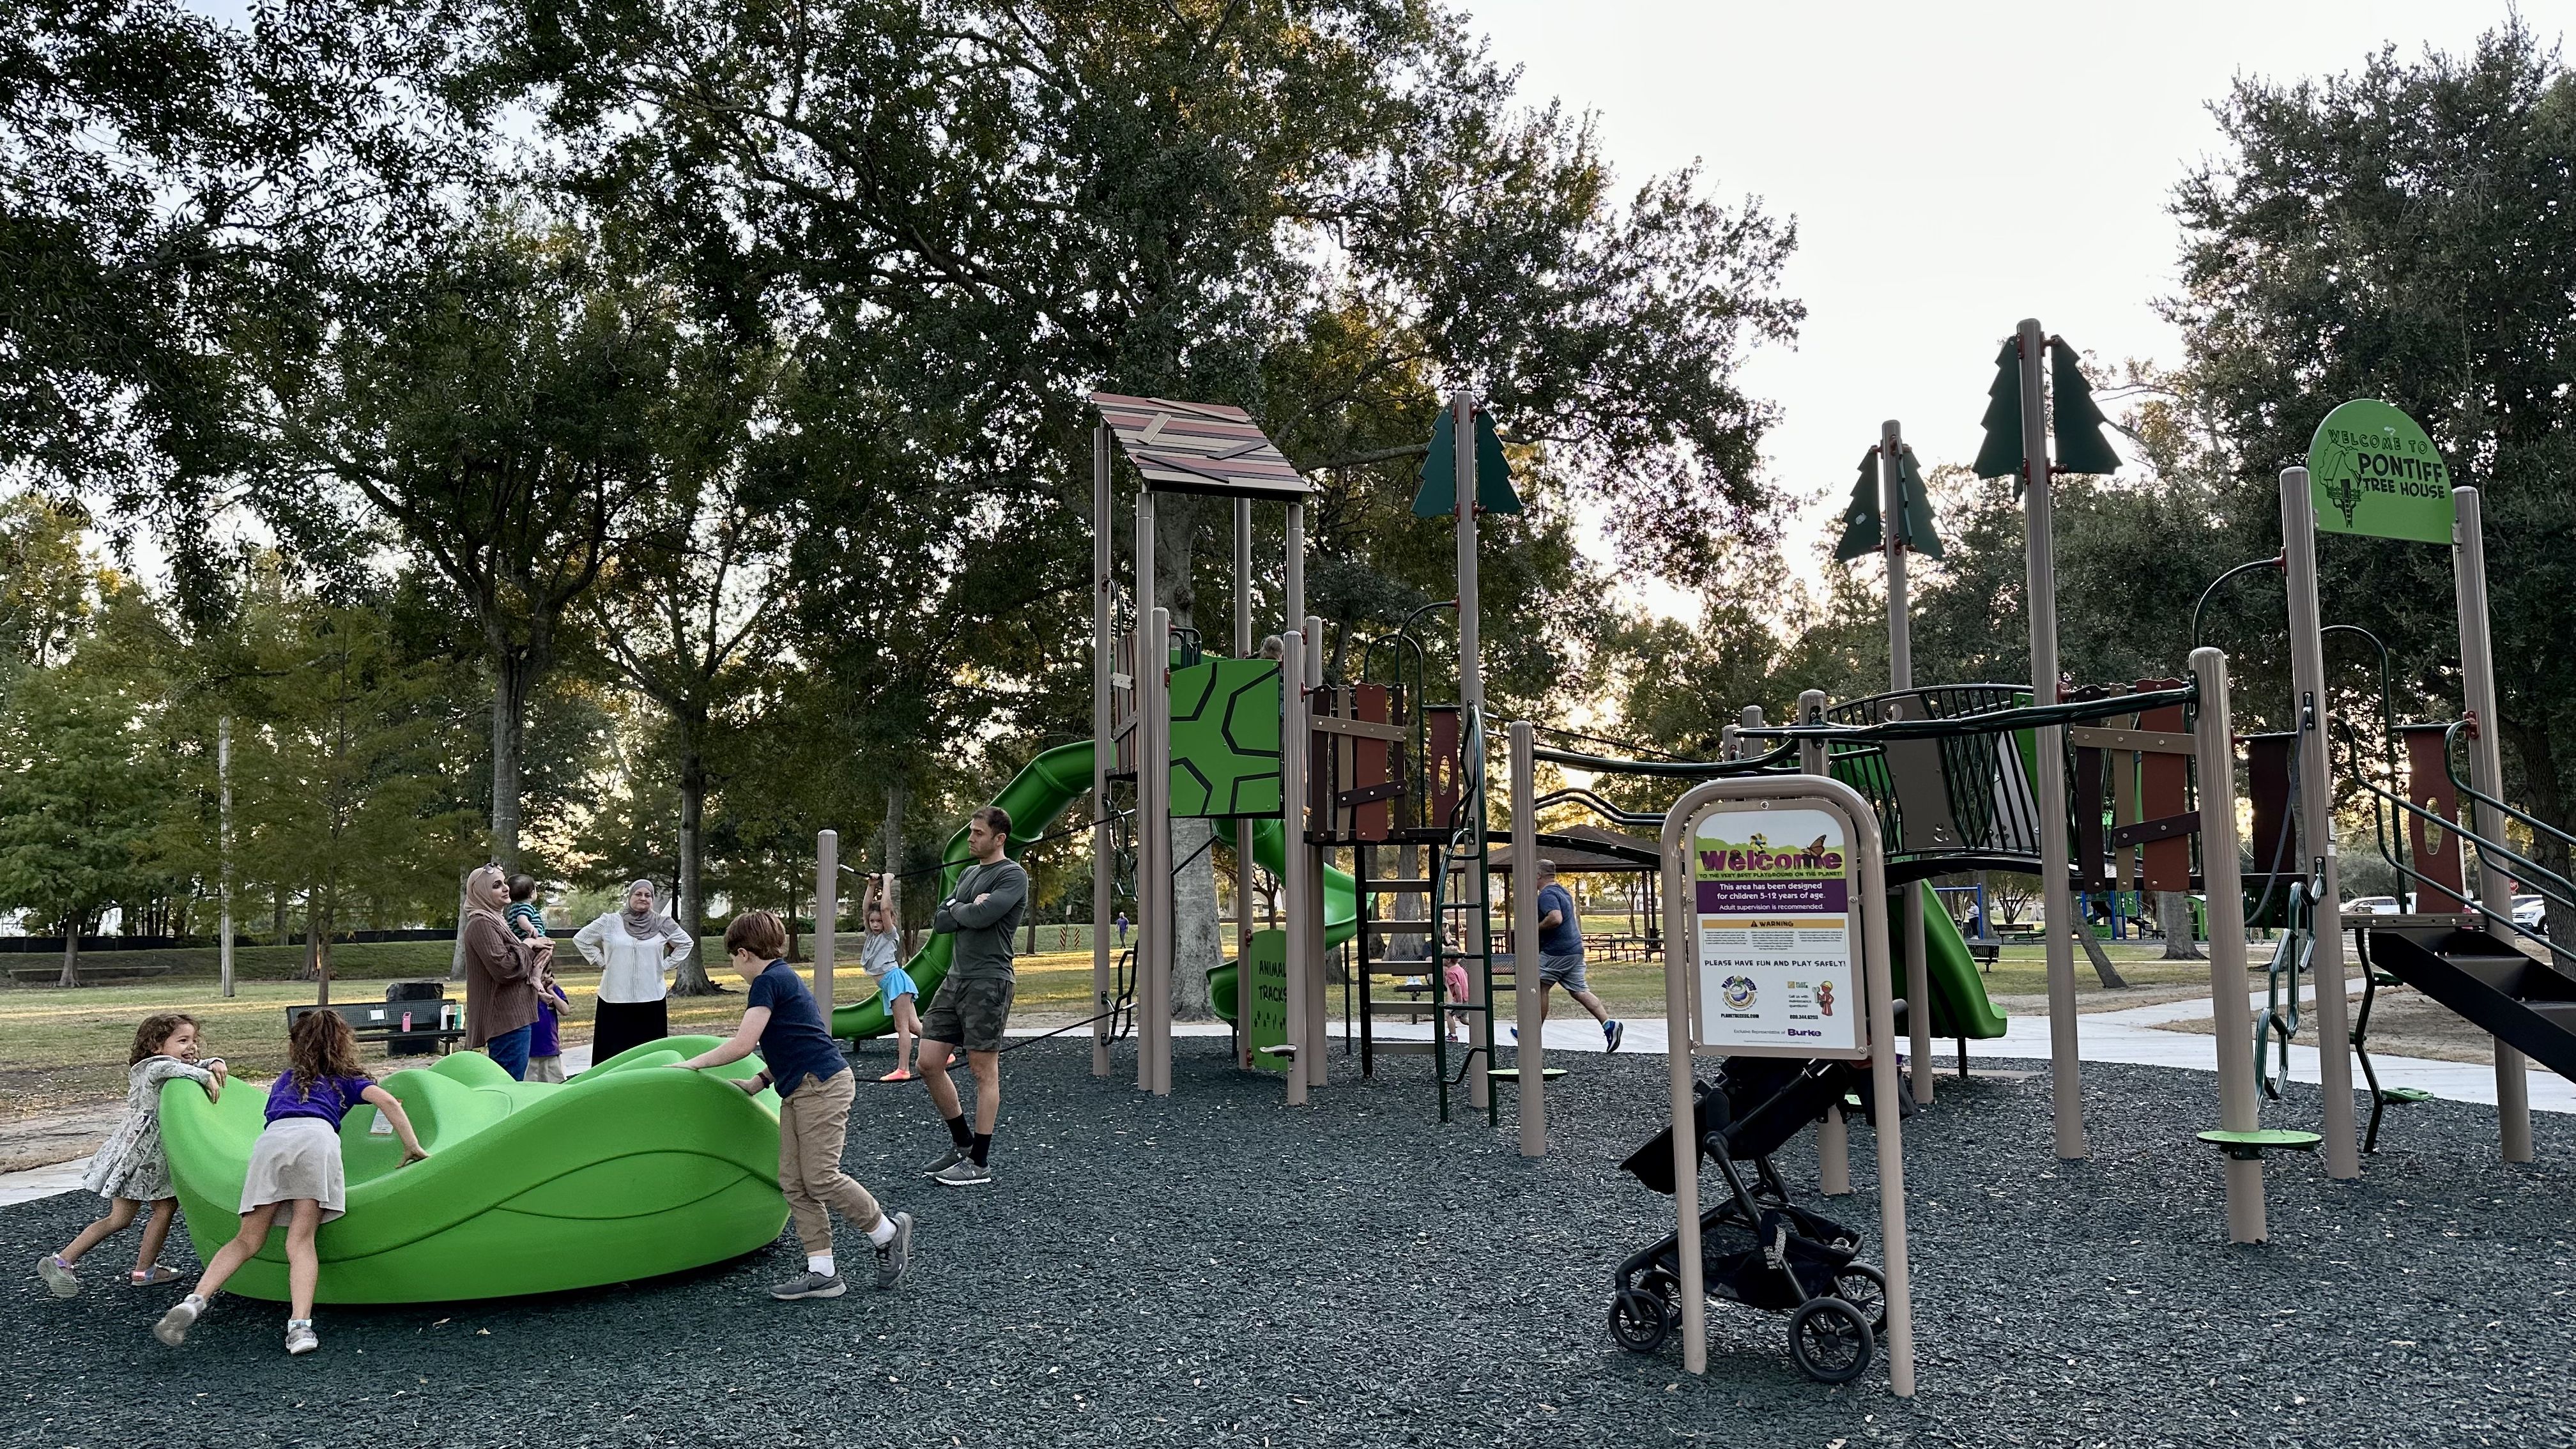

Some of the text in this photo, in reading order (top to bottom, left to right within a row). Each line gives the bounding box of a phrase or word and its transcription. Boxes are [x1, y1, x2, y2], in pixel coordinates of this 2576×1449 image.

[2327, 429, 2428, 454] WELCOME TO
[2358, 452, 2442, 483] PONTIFF
[2362, 477, 2445, 499] TREE HOUSE
[1699, 849, 1843, 871] Welcome
[1788, 882, 1822, 891] designed
[1259, 960, 1287, 978] ANIMAL
[1788, 1029, 1821, 1037] Burke
